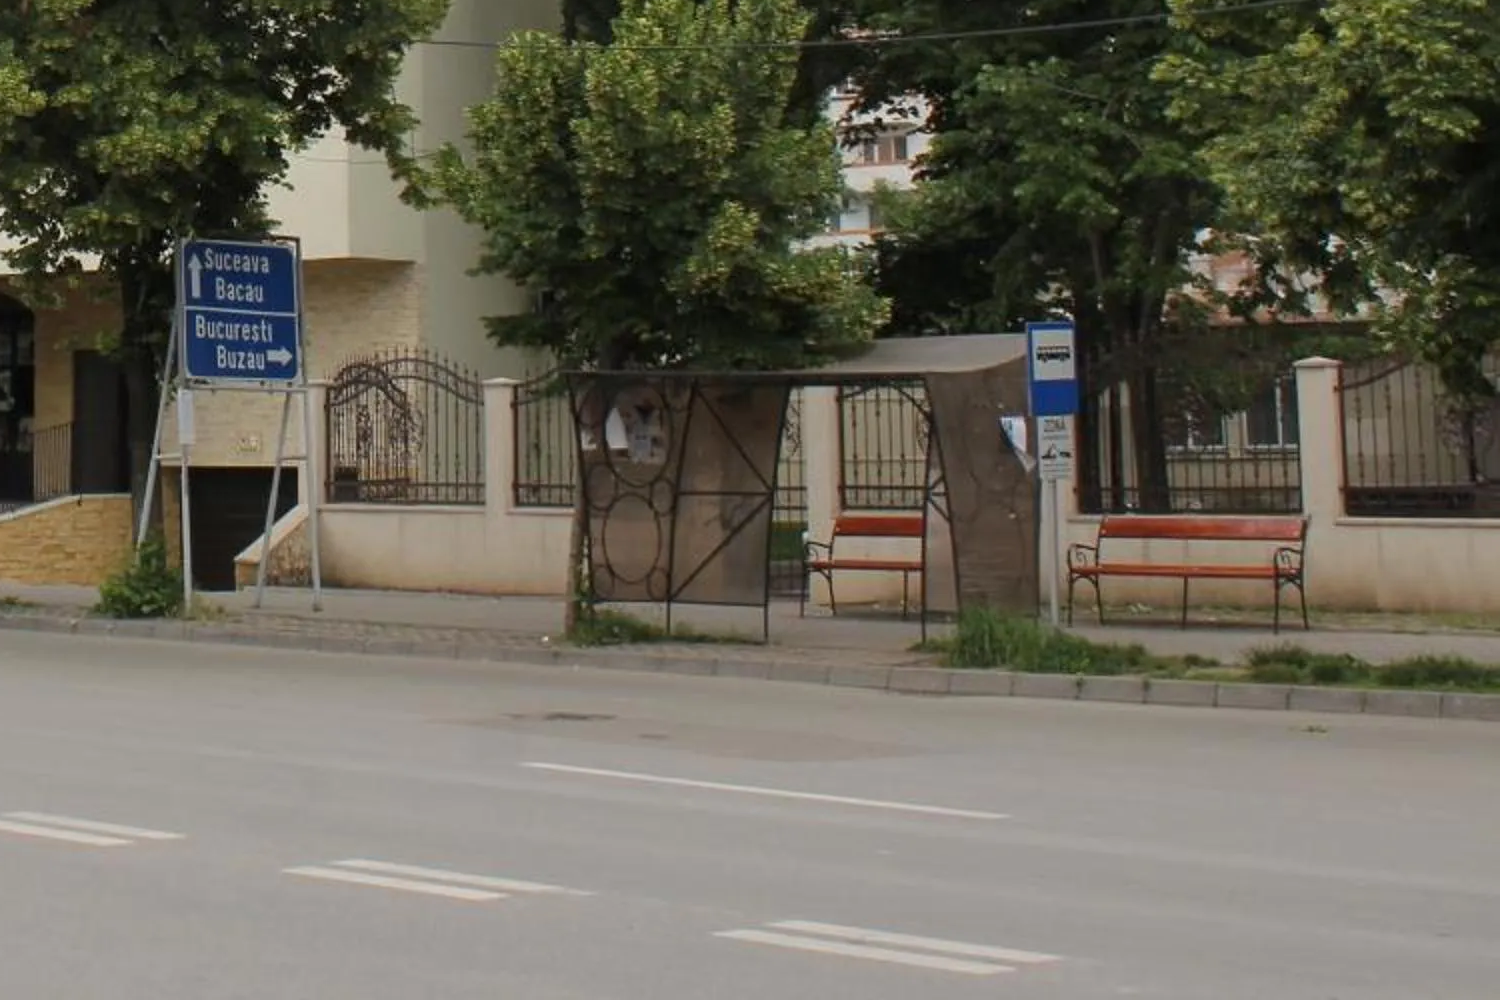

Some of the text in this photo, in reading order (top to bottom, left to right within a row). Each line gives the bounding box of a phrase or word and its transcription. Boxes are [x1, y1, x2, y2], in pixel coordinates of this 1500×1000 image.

[204, 248, 270, 274] Suceava
[215, 277, 264, 303] Bacau
[216, 345, 265, 370] Buzau
